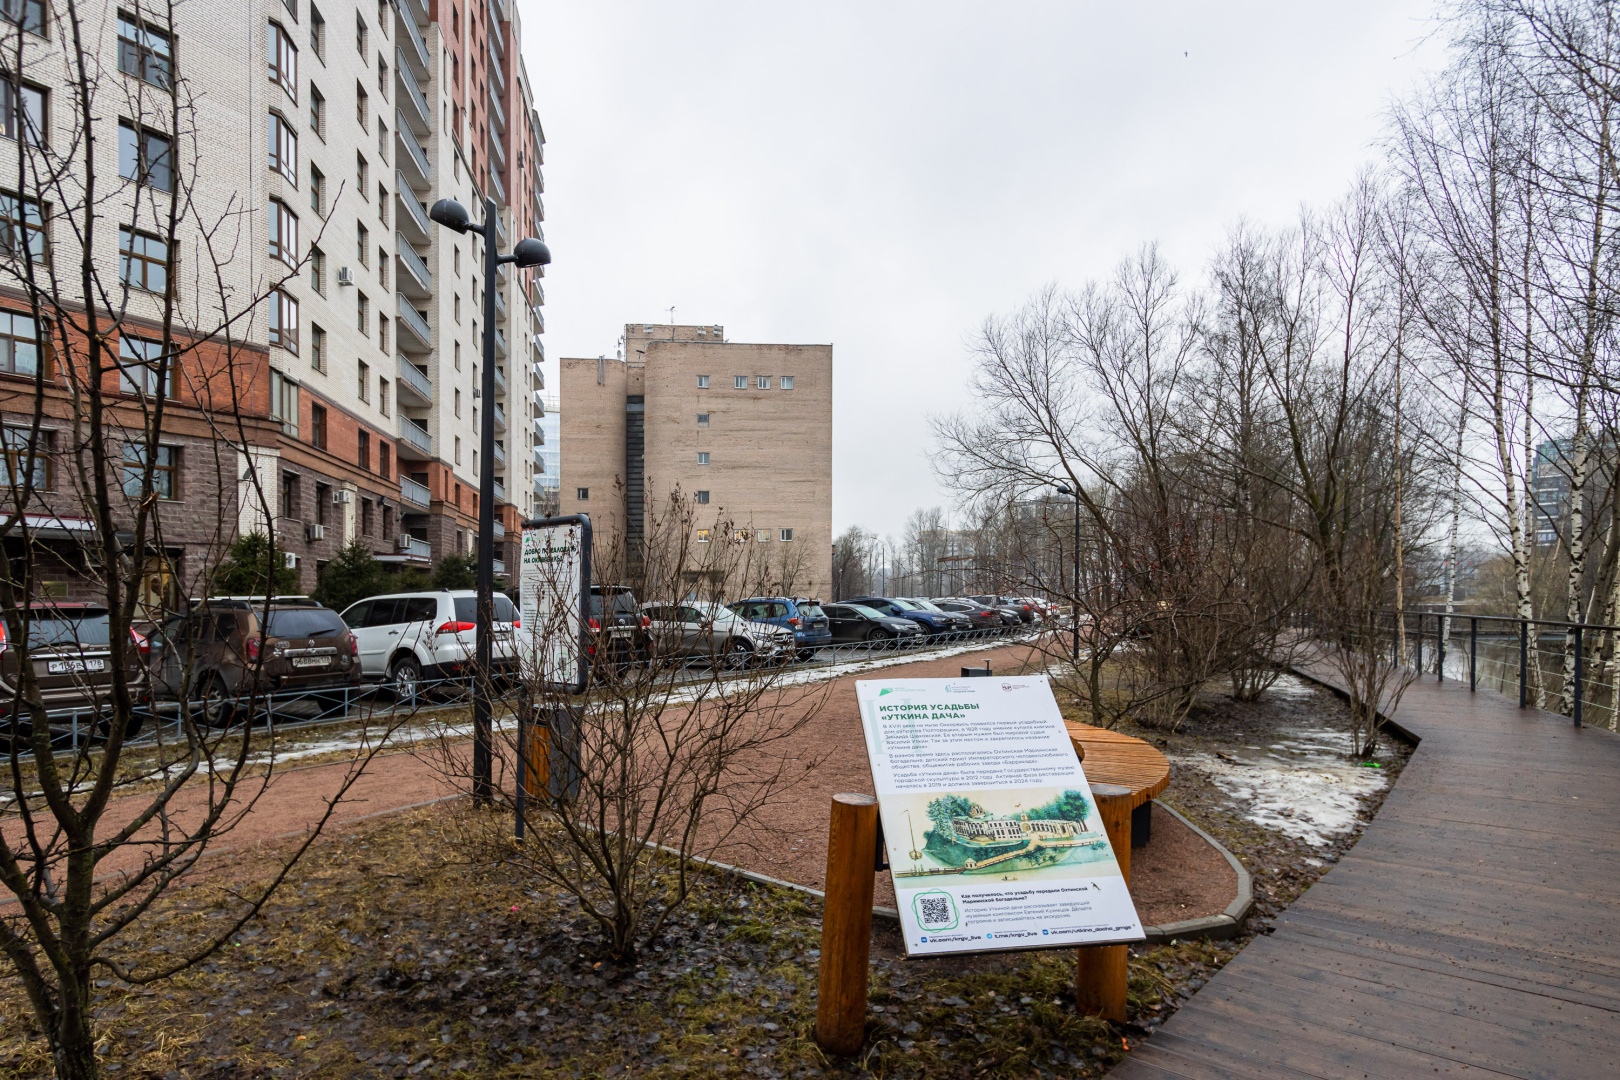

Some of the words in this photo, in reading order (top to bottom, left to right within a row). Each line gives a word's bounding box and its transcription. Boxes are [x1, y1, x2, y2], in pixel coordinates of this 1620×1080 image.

[879, 704, 928, 712] ИСТОРИЯ
[930, 703, 979, 711] УСАДЬБЫ
[881, 713, 929, 721] «УТКИНА
[931, 712, 966, 720] ДАЧА»
